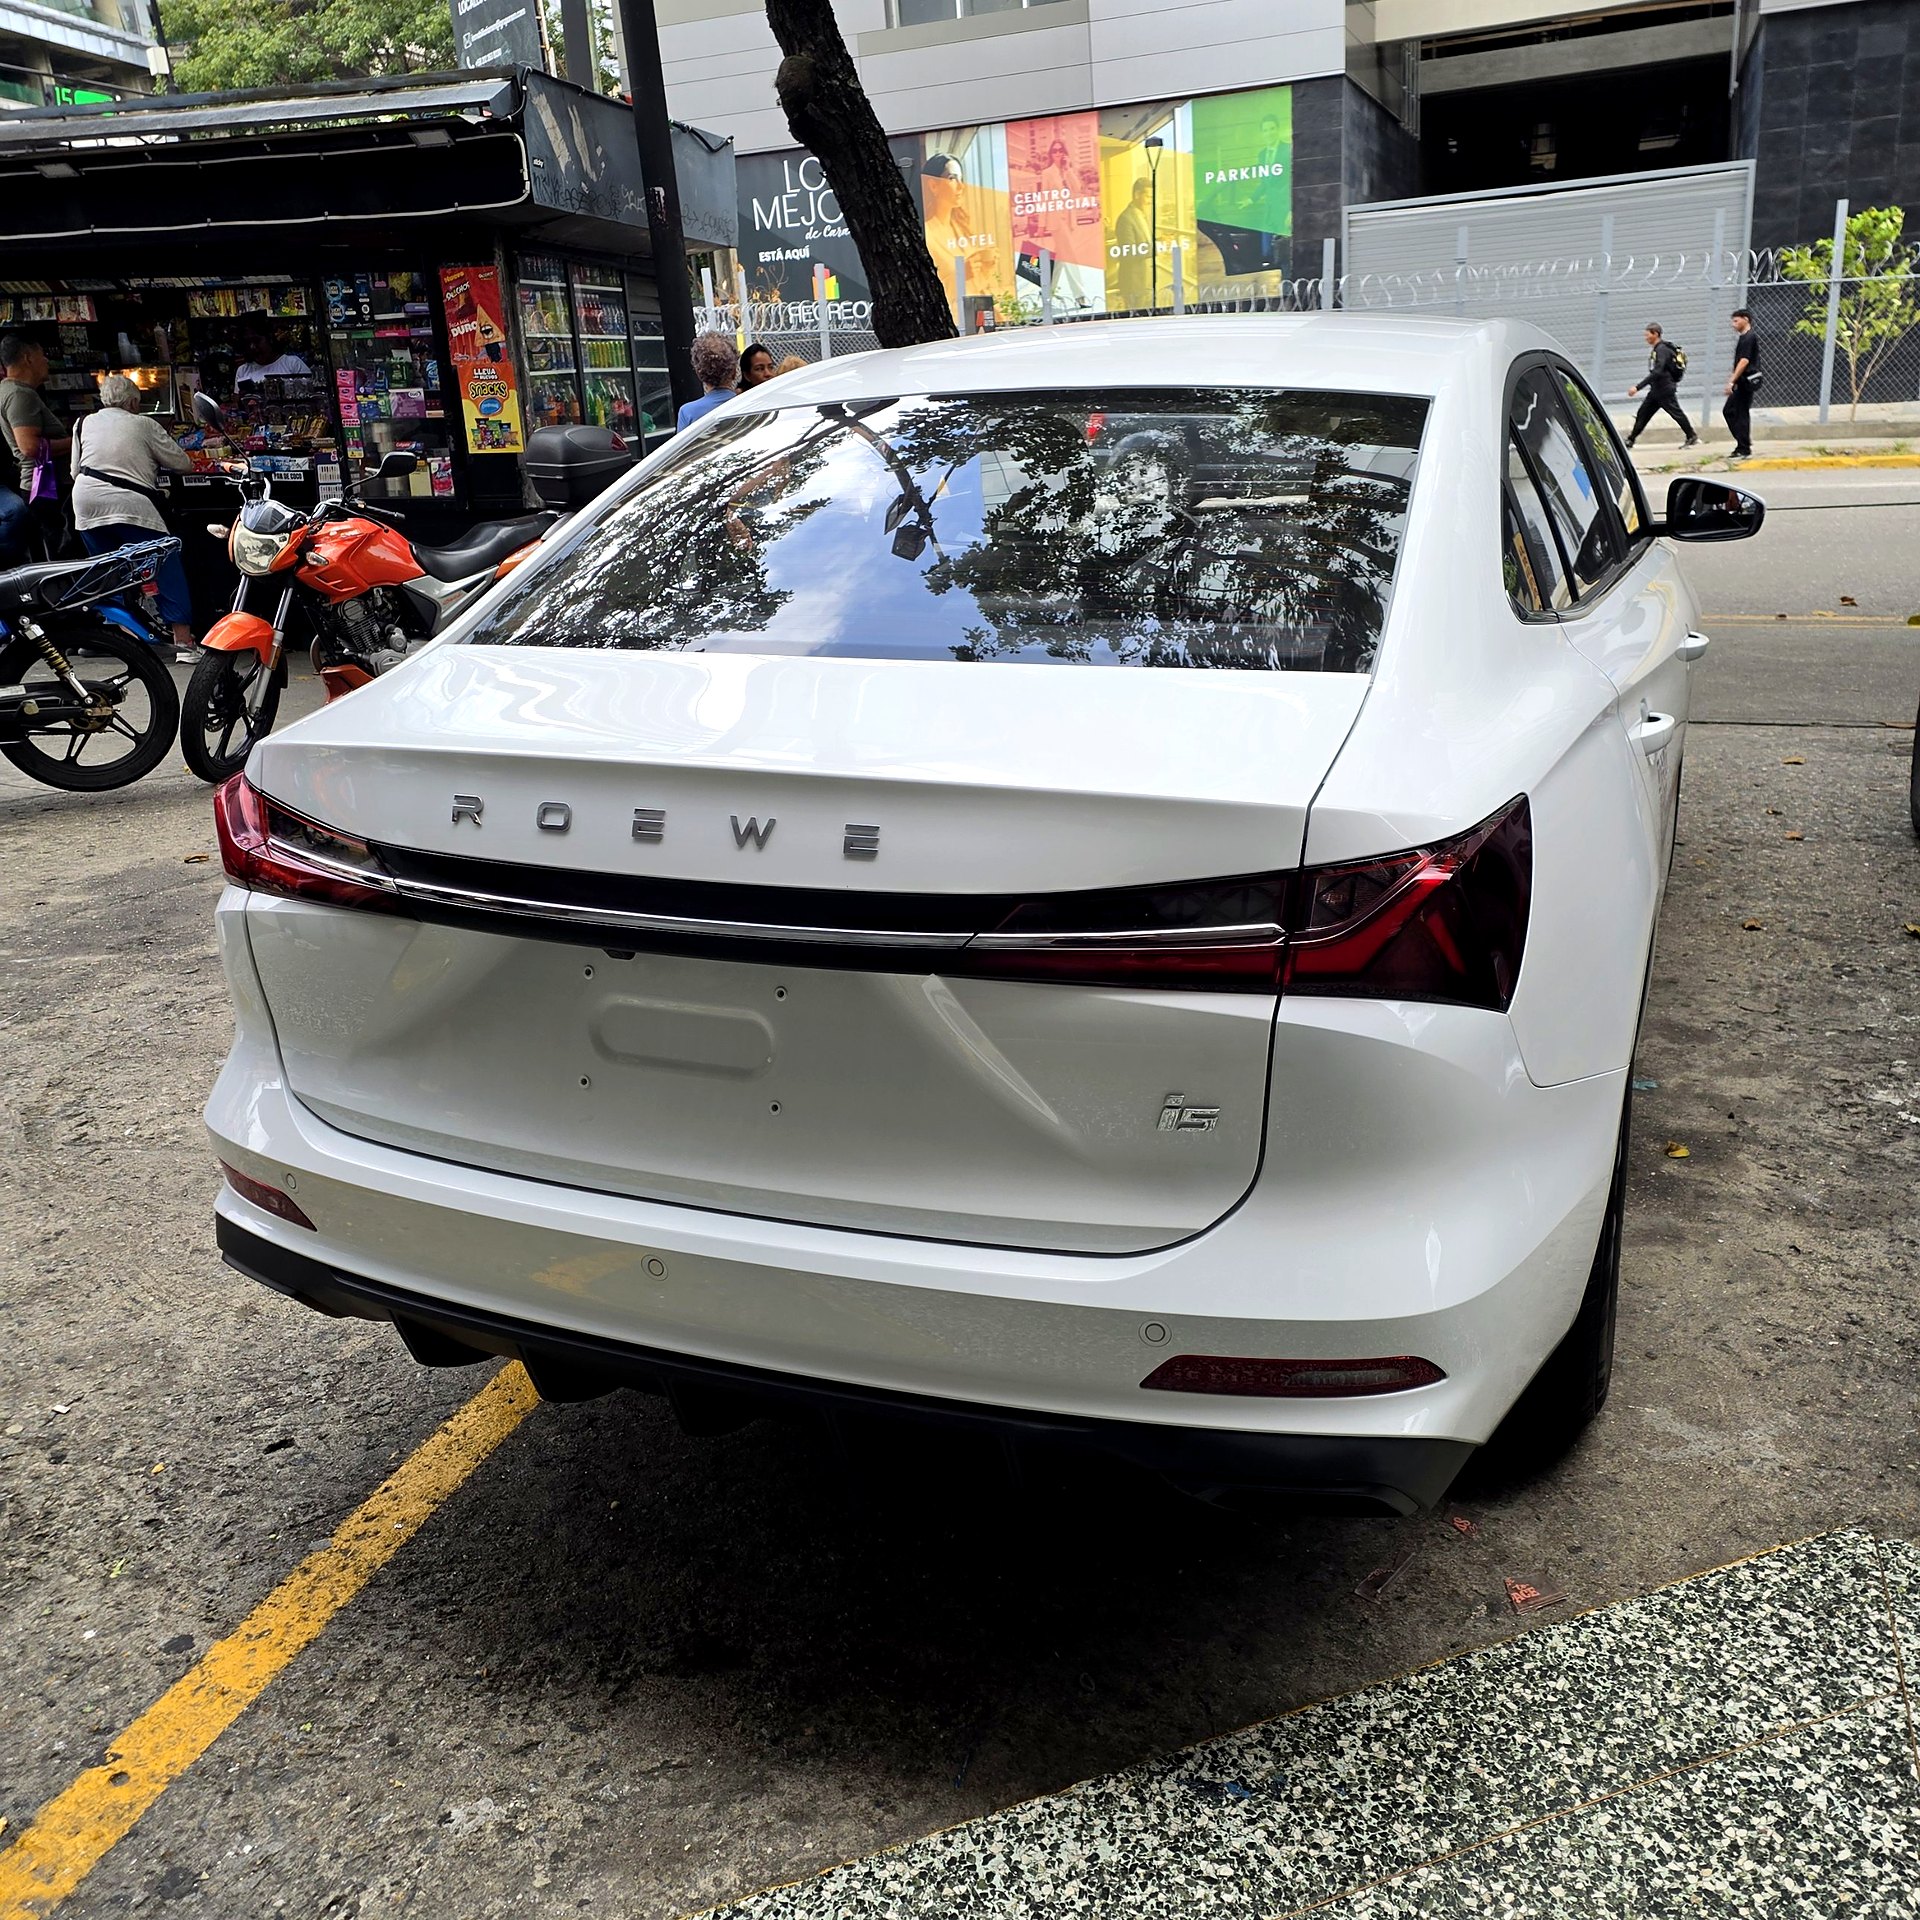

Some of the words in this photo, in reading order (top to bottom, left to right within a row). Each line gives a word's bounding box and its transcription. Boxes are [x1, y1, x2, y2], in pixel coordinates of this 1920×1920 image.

[1204, 163, 1284, 185] PARKING
[1013, 188, 1072, 204] CENTRO
[752, 188, 844, 231] MEJO
[1014, 196, 1099, 216] COMERCIAL
[805, 225, 821, 240] de
[823, 224, 850, 238] Cara
[946, 233, 996, 250] HOTEL
[1109, 239, 1191, 258] OFICNAS
[758, 247, 783, 262] ESTÁ
[784, 245, 810, 260] AQUÍ
[451, 321, 478, 338] DURO
[290, 472, 303, 480] COCO
[451, 793, 881, 859] ROEWE
